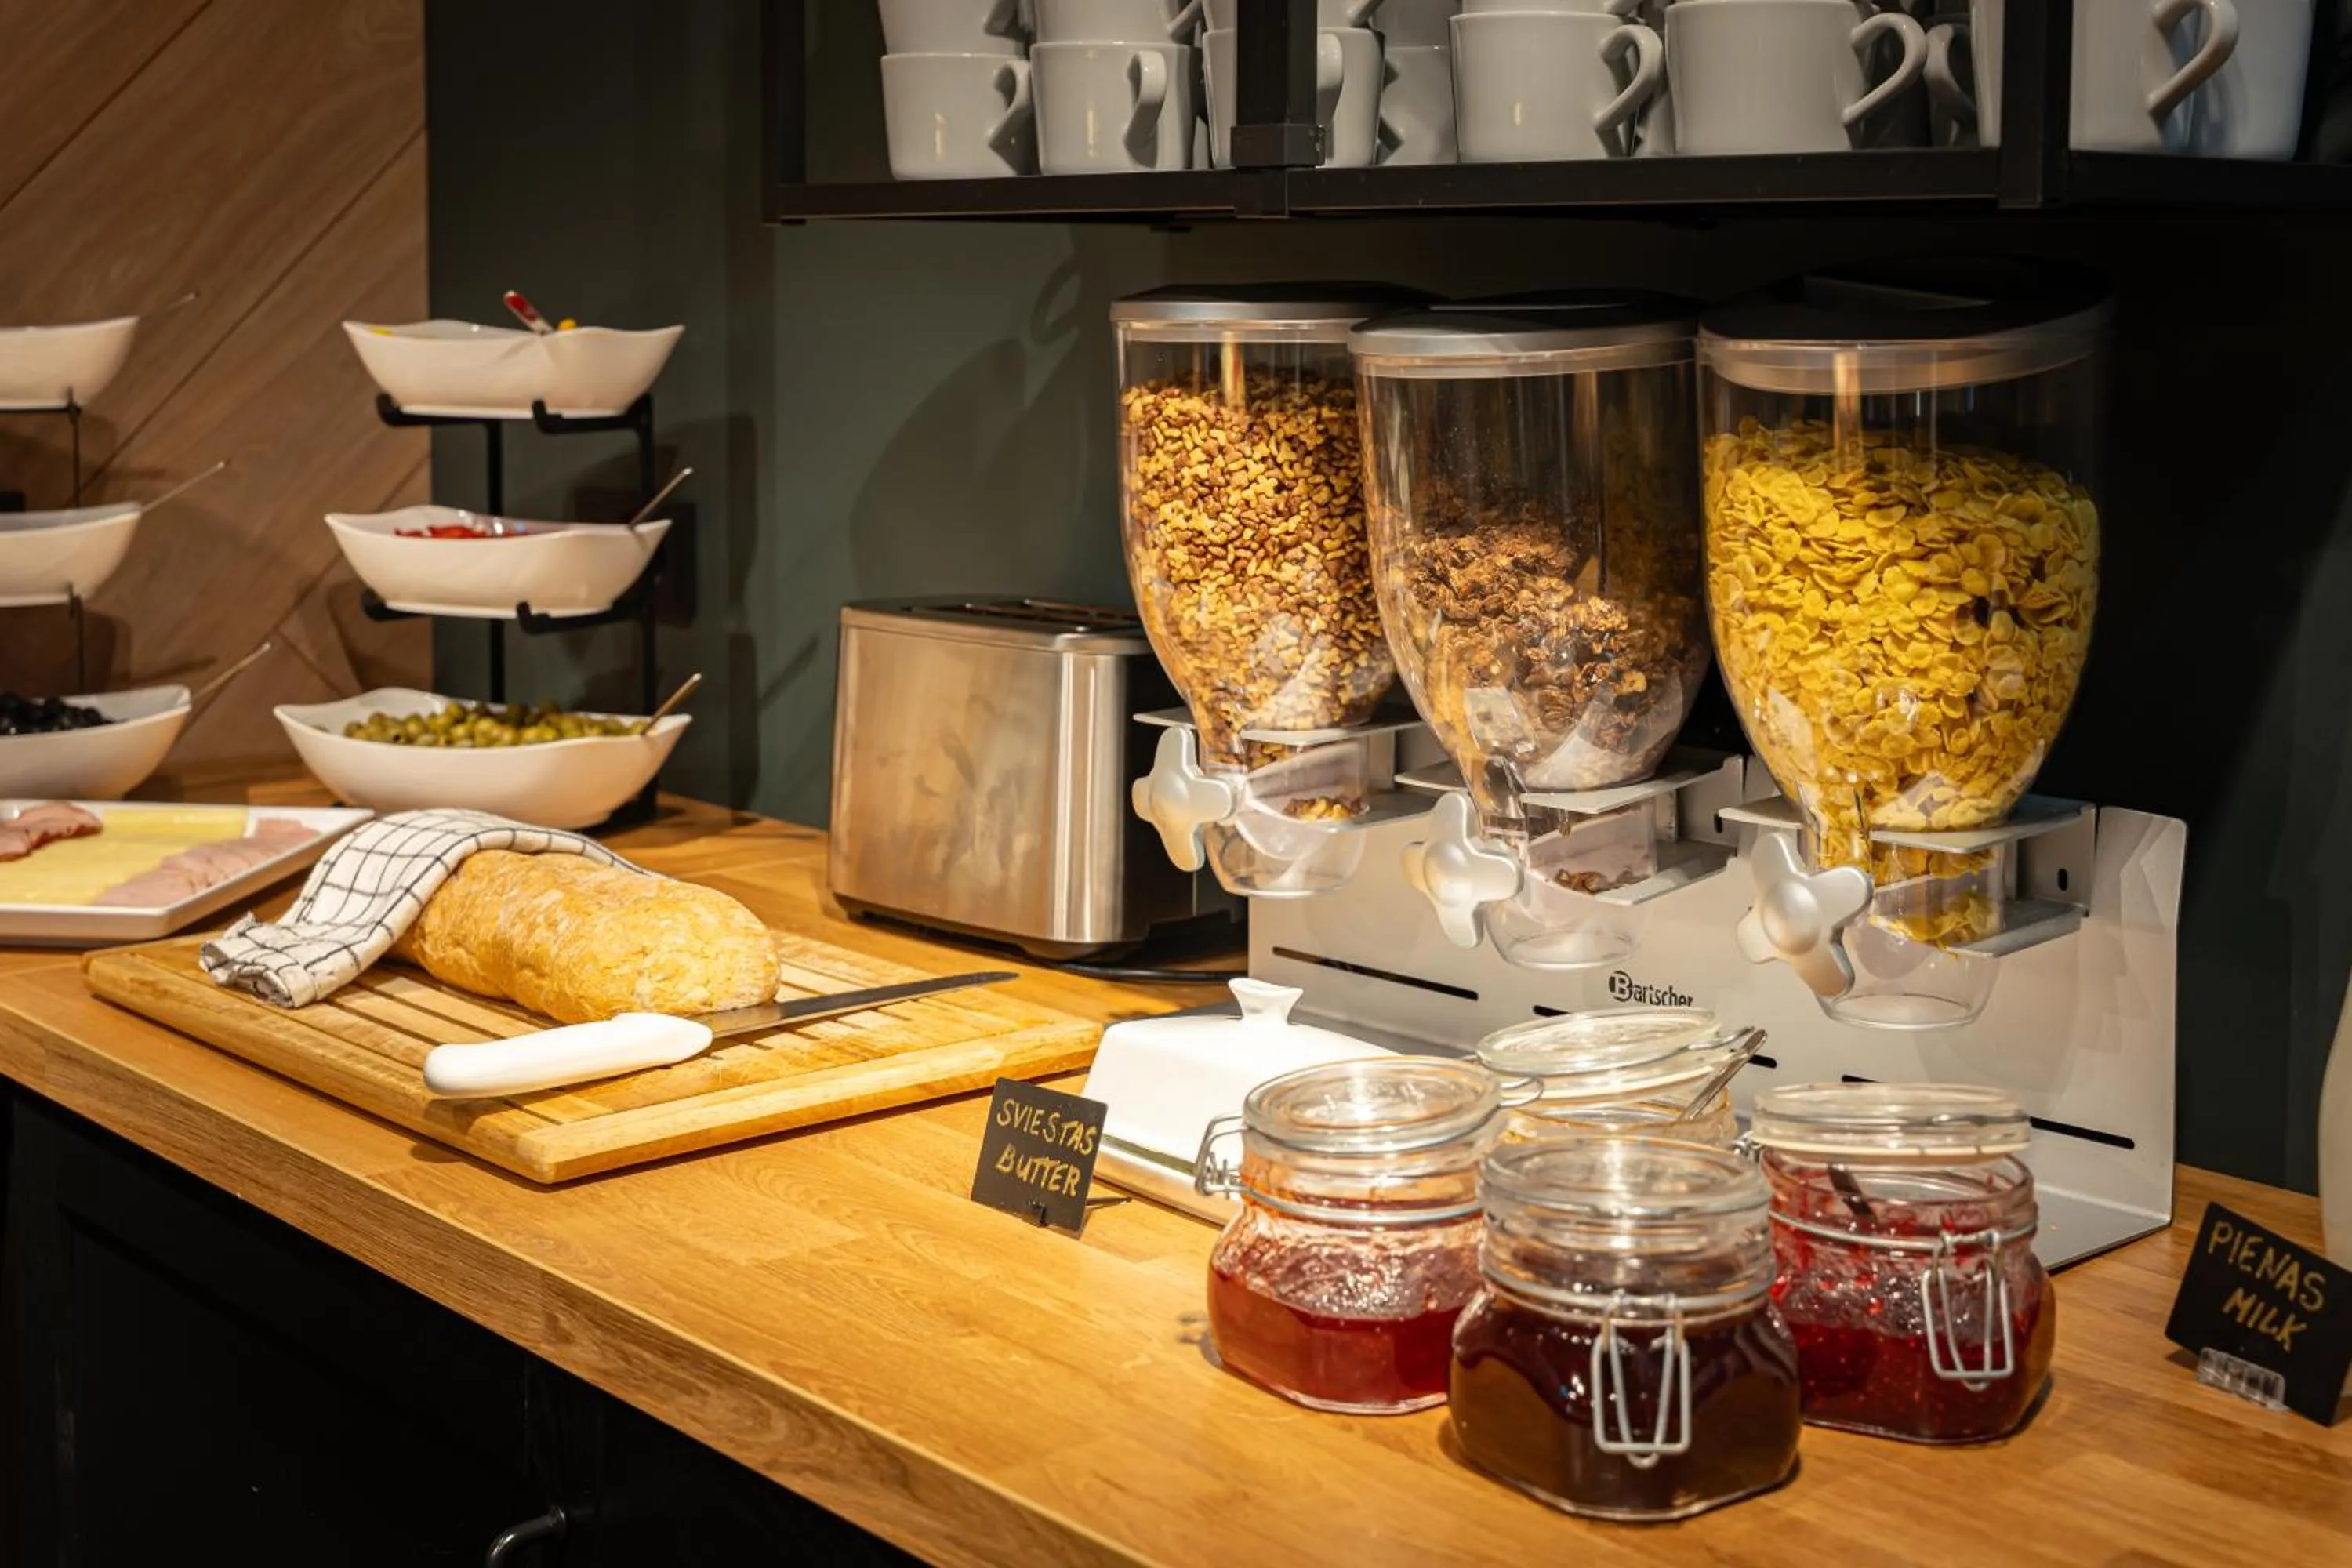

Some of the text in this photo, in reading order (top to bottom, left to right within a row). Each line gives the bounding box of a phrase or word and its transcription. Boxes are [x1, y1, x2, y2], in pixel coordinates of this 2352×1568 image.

[1608, 970, 1693, 1007] Bartscher
[996, 1098, 1097, 1156] SVIESTAS
[994, 1142, 1081, 1197] BUTTER
[2207, 1220, 2326, 1312] PIENAS
[2221, 1287, 2308, 1353] MILK
